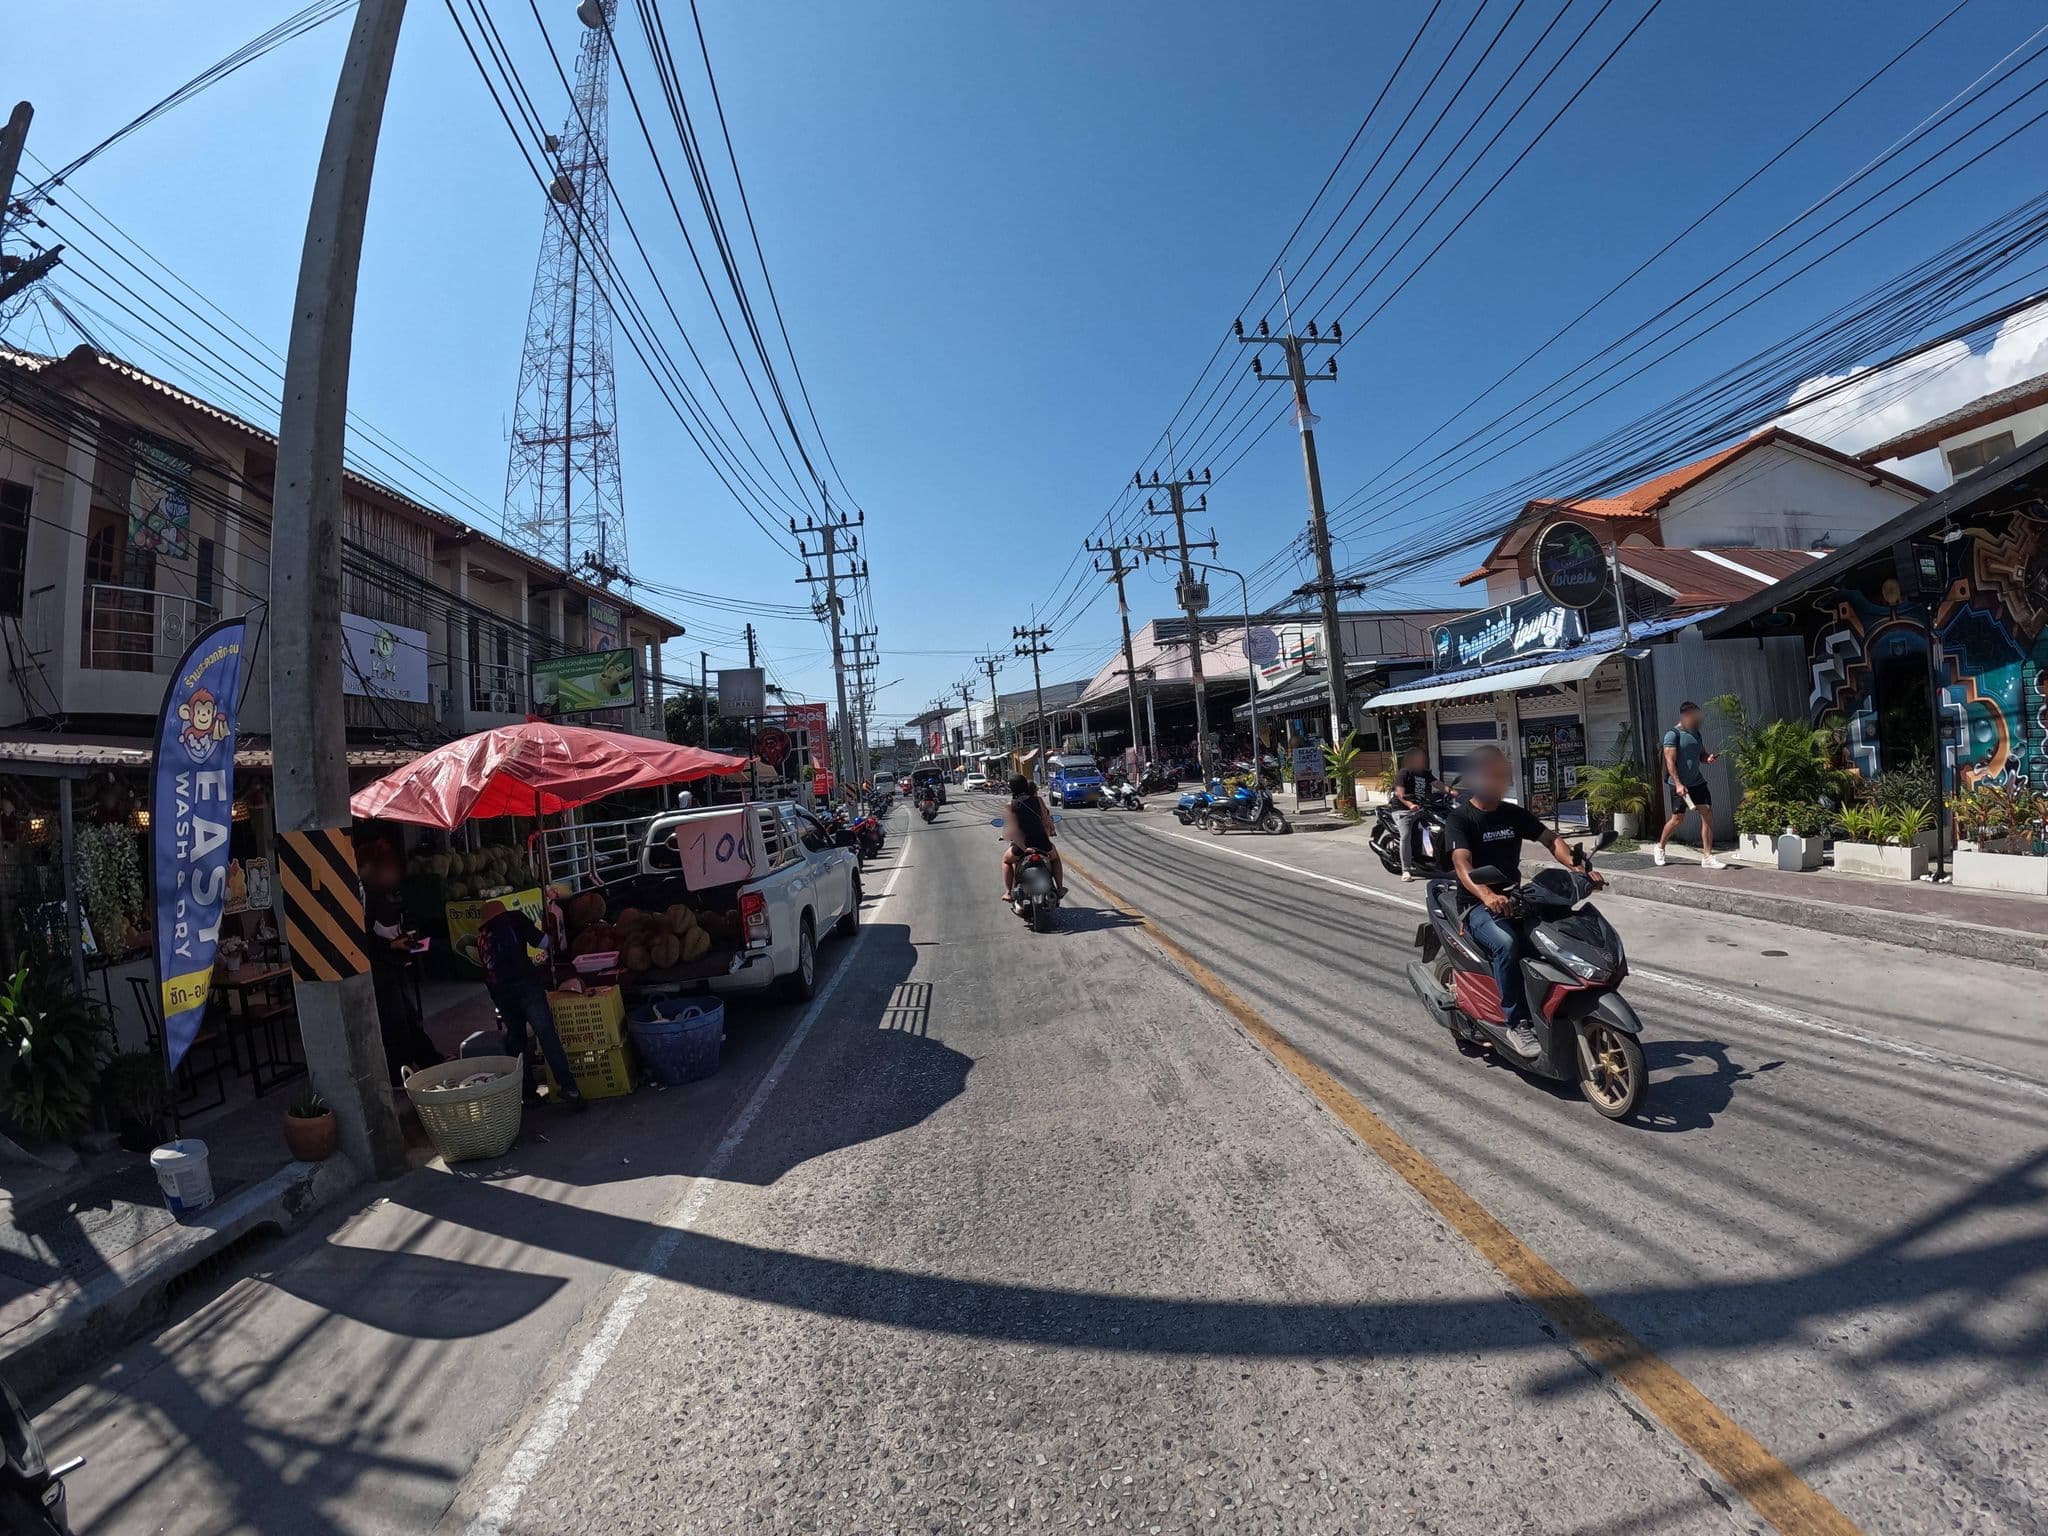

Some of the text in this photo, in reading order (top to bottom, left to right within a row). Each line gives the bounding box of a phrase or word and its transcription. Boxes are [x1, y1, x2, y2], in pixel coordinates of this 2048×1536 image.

[1535, 766, 1547, 776] 16
[1566, 772, 1574, 781] 14
[174, 771, 192, 959] WASH & DRY
[190, 769, 228, 944] EASY
